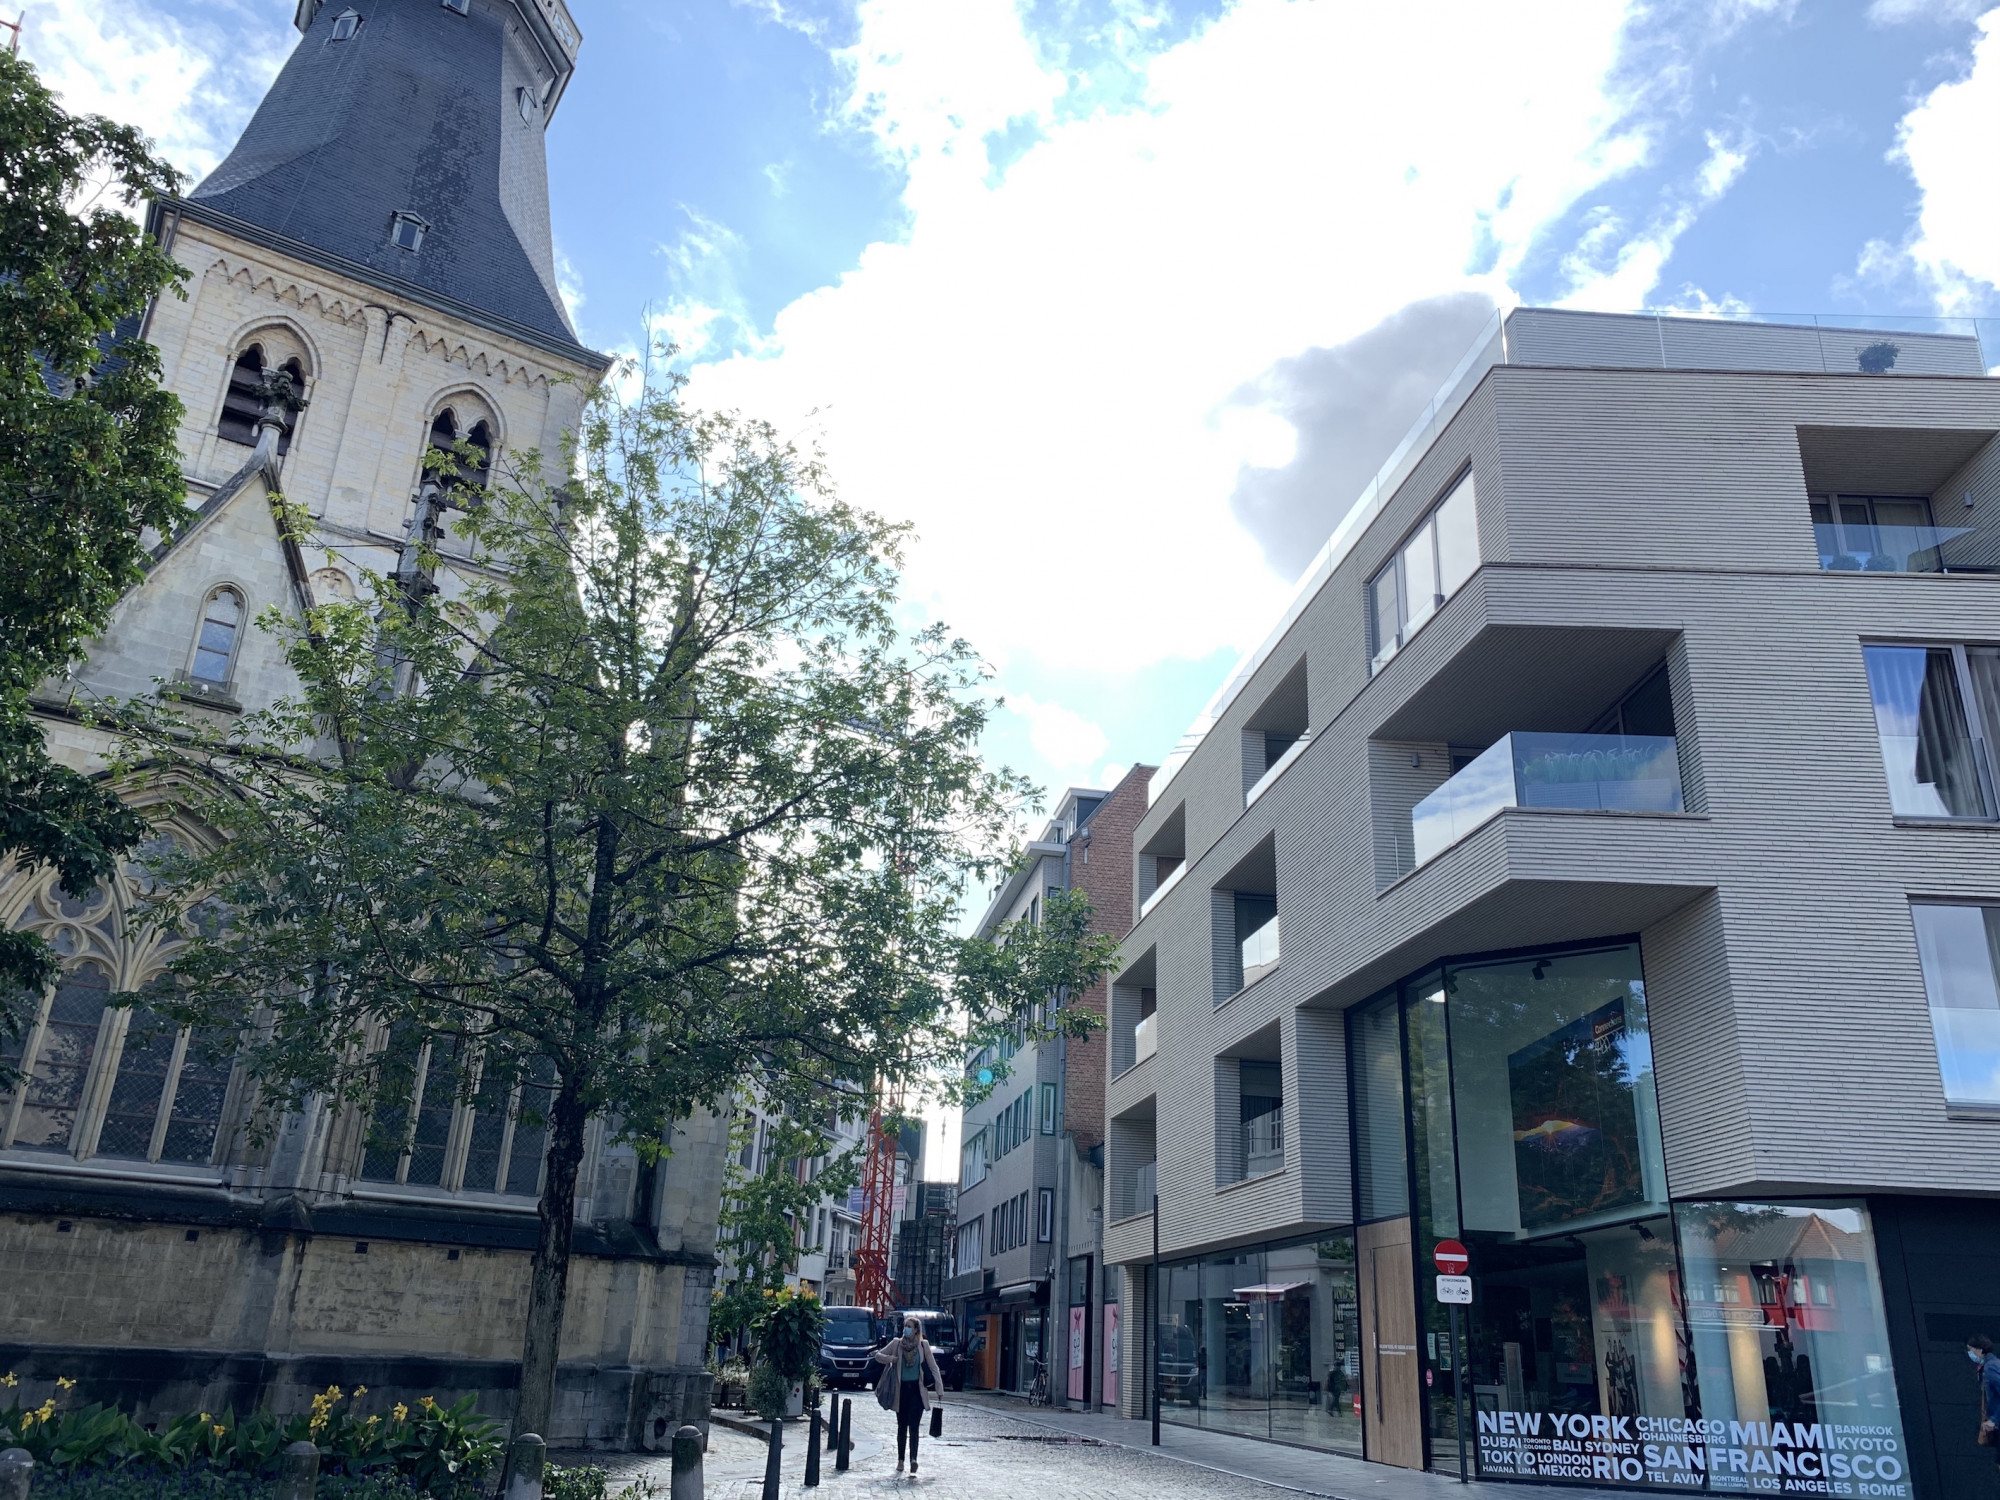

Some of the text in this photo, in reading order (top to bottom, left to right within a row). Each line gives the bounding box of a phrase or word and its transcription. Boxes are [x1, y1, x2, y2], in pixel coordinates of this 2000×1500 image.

[1478, 1410, 1632, 1440] NEW YORK
[1635, 1416, 1725, 1434] CHICAGO
[1834, 1424, 1894, 1436] BANGKOK
[1480, 1436, 1521, 1448] DUBAI
[1638, 1432, 1726, 1444] JOHANNESBURG
[1729, 1420, 1836, 1450] MIAMI
[1552, 1440, 1581, 1452] BALI
[1585, 1442, 1640, 1455] SYDNEY
[1836, 1437, 1898, 1452] KYOTO
[1482, 1450, 1536, 1465] TOKYO
[1538, 1452, 1591, 1466] LONDON
[1643, 1444, 1902, 1481] SAN FRANCISCO
[1482, 1465, 1514, 1474] HAVANA
[1538, 1464, 1592, 1478] MEXICO
[1592, 1456, 1643, 1482] RIO
[1646, 1471, 1704, 1485] TEL AVIV
[1710, 1475, 1748, 1483] MONTREAL
[1753, 1477, 1852, 1494] LOS ANGELES
[1858, 1483, 1906, 1497] ROME
